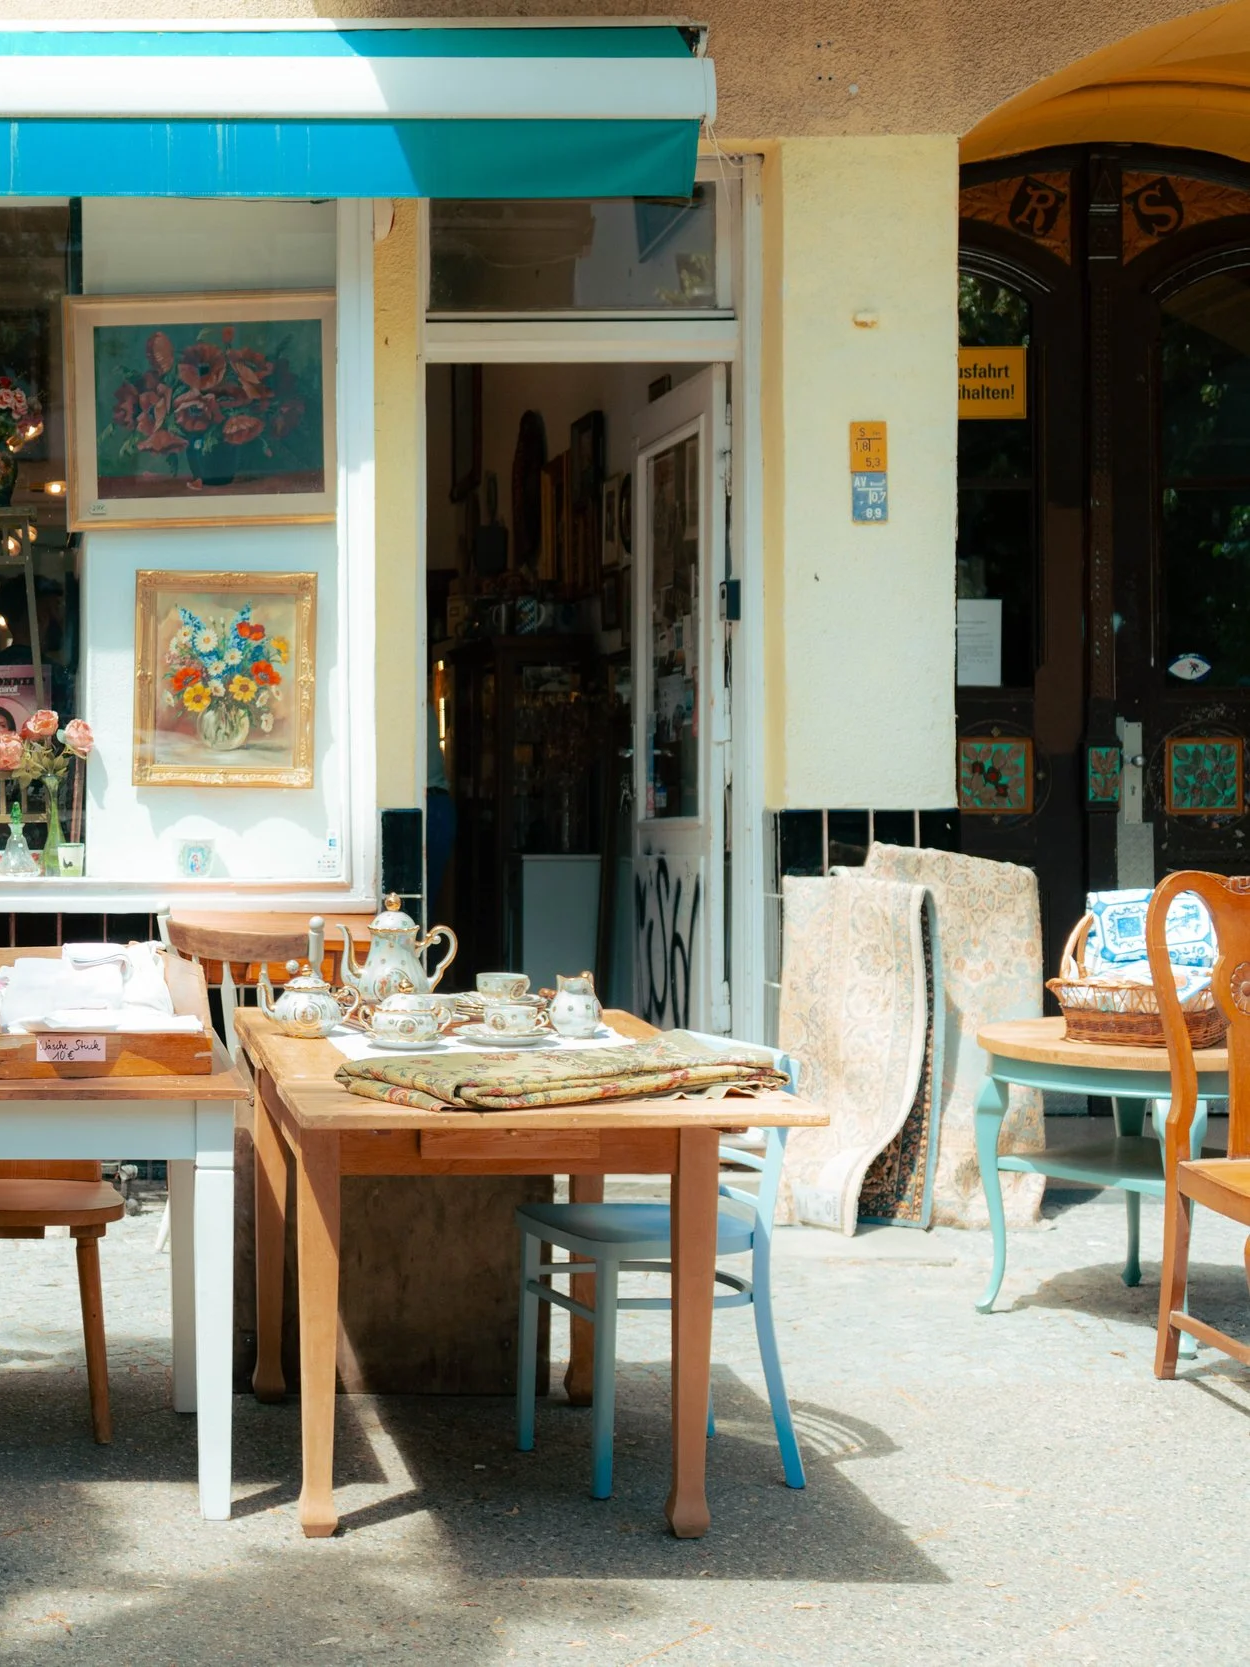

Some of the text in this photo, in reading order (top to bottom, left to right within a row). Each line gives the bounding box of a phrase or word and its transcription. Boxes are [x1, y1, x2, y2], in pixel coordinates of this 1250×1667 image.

[1015, 185, 1056, 235] R
[1138, 184, 1179, 237] S
[859, 427, 866, 437] S
[865, 457, 881, 468] 5,3
[854, 476, 867, 488] AV
[865, 507, 882, 519] 8,9
